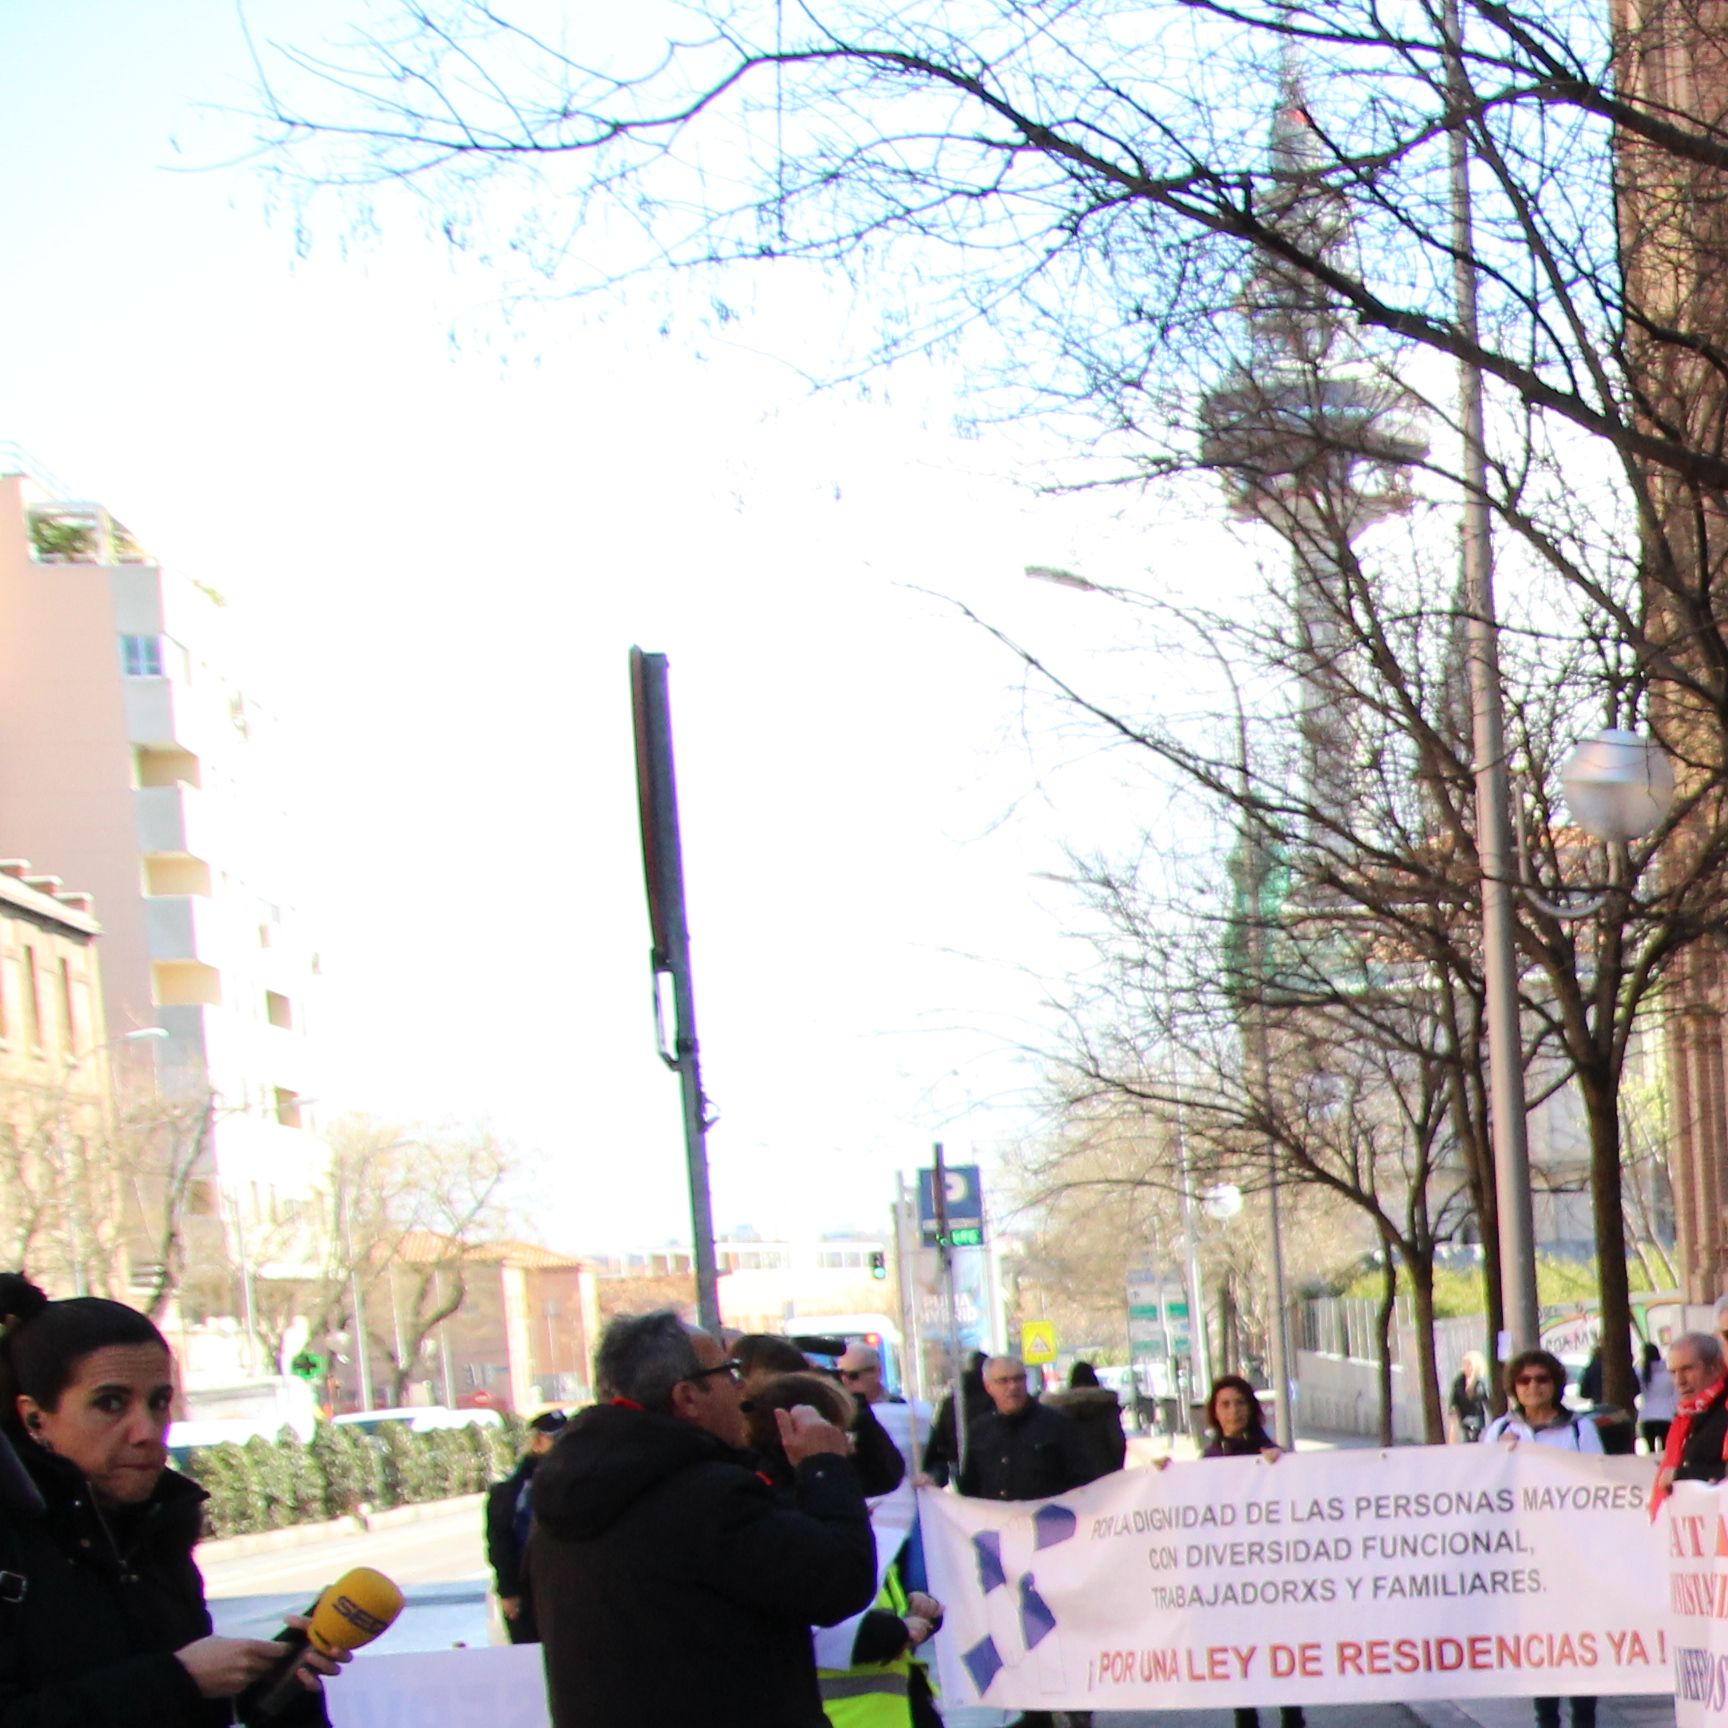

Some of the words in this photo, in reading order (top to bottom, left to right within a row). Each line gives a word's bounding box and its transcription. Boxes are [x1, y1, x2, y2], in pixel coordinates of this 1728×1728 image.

[1091, 1517, 1114, 1540] POR
[1133, 1503, 1236, 1533] DIGNIDAD
[1246, 1501, 1280, 1525] DE
[1291, 1498, 1344, 1522] LAS
[1355, 1489, 1514, 1520] PERSONAS
[1523, 1485, 1648, 1513] MAYORES,
[1150, 1546, 1178, 1570] CON
[1186, 1537, 1351, 1568] DIVERSIDAD
[1362, 1529, 1535, 1560] FUNCIONAL,
[1151, 1579, 1336, 1609] TRABAJADORXS
[1346, 1577, 1363, 1600] Y
[1372, 1569, 1547, 1599] FAMILIARES.
[1099, 1650, 1135, 1684] POR
[1140, 1648, 1180, 1683] UNA
[1186, 1645, 1257, 1681] LEY
[1269, 1643, 1323, 1678] DE
[1337, 1630, 1598, 1676] RESIDENCIAS
[1606, 1629, 1650, 1667] YA
